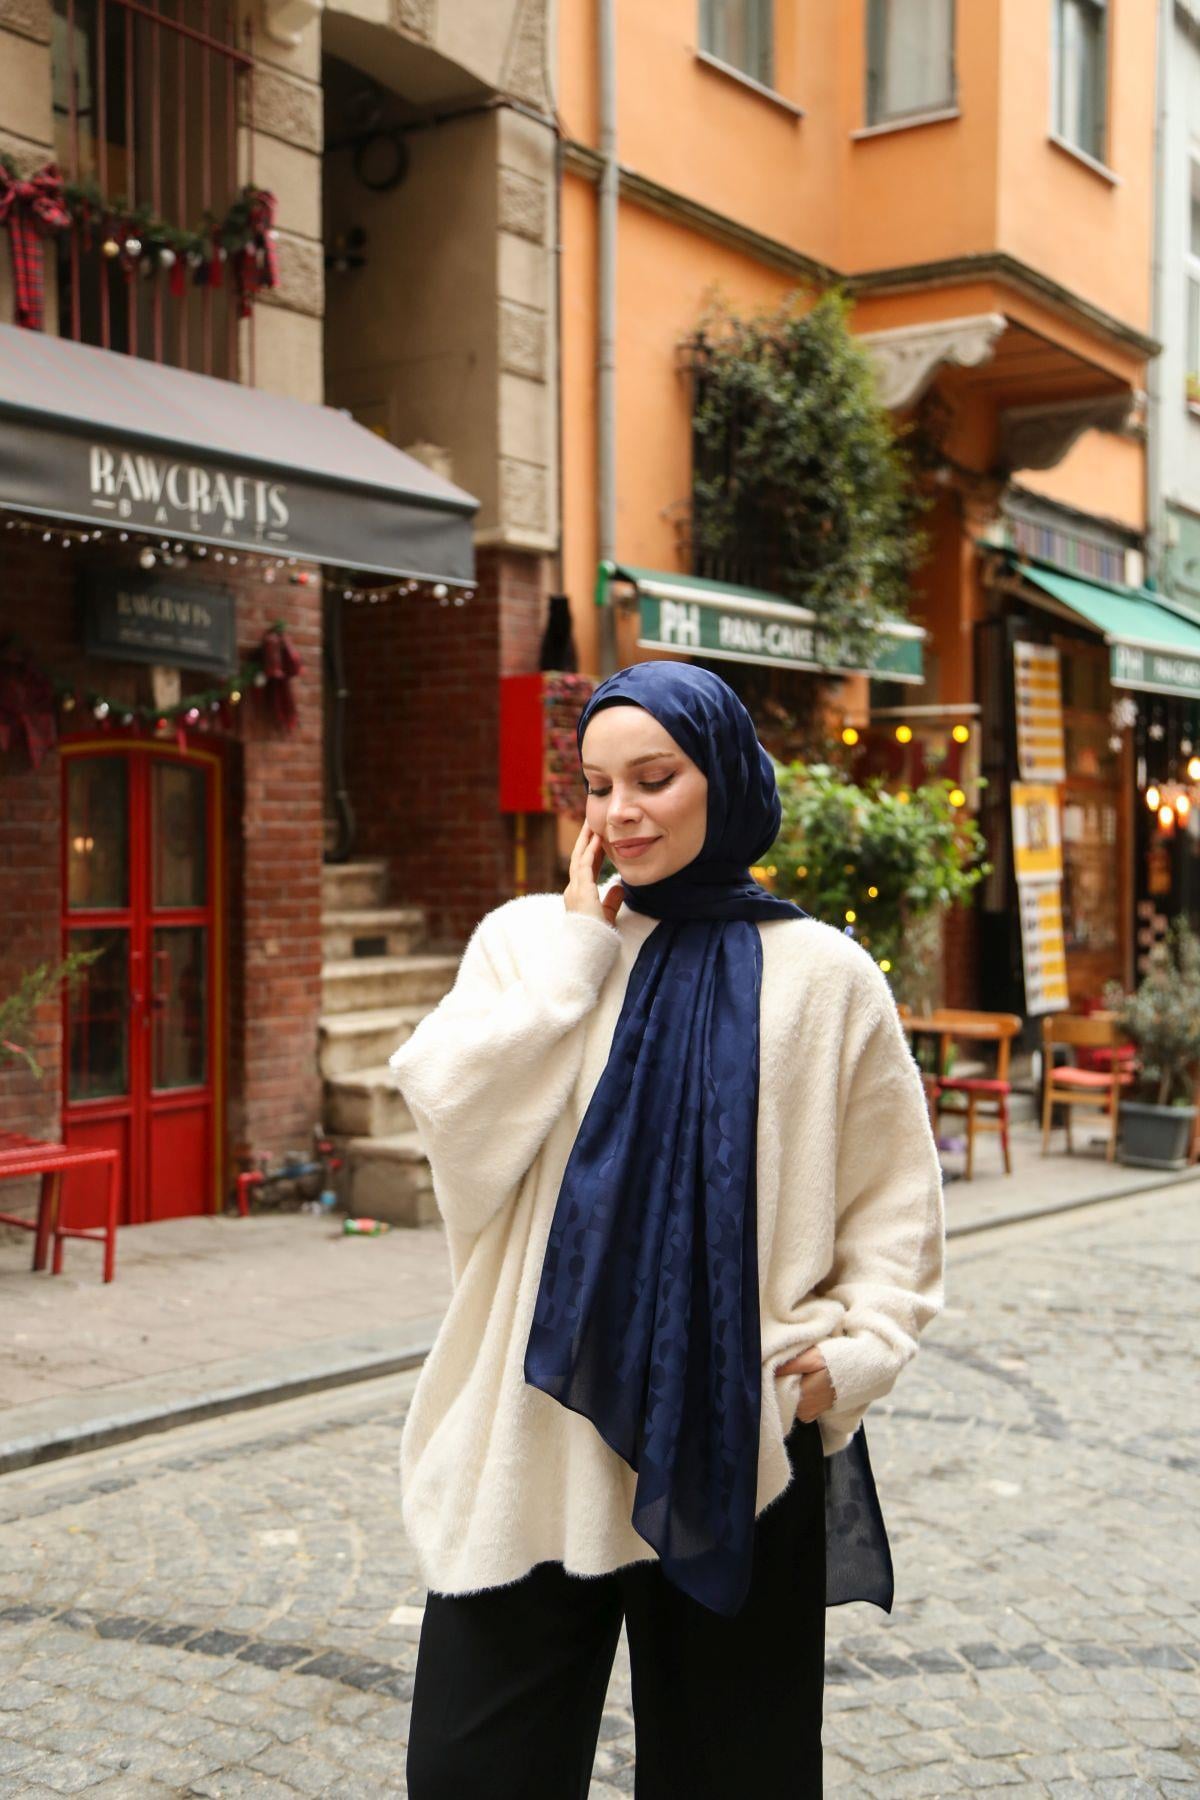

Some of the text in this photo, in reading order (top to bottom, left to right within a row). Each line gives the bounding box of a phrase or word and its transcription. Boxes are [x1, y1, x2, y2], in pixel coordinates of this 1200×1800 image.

[90, 446, 289, 528] RAWCRAFTS
[660, 600, 700, 647] PH
[1116, 645, 1144, 681] PH
